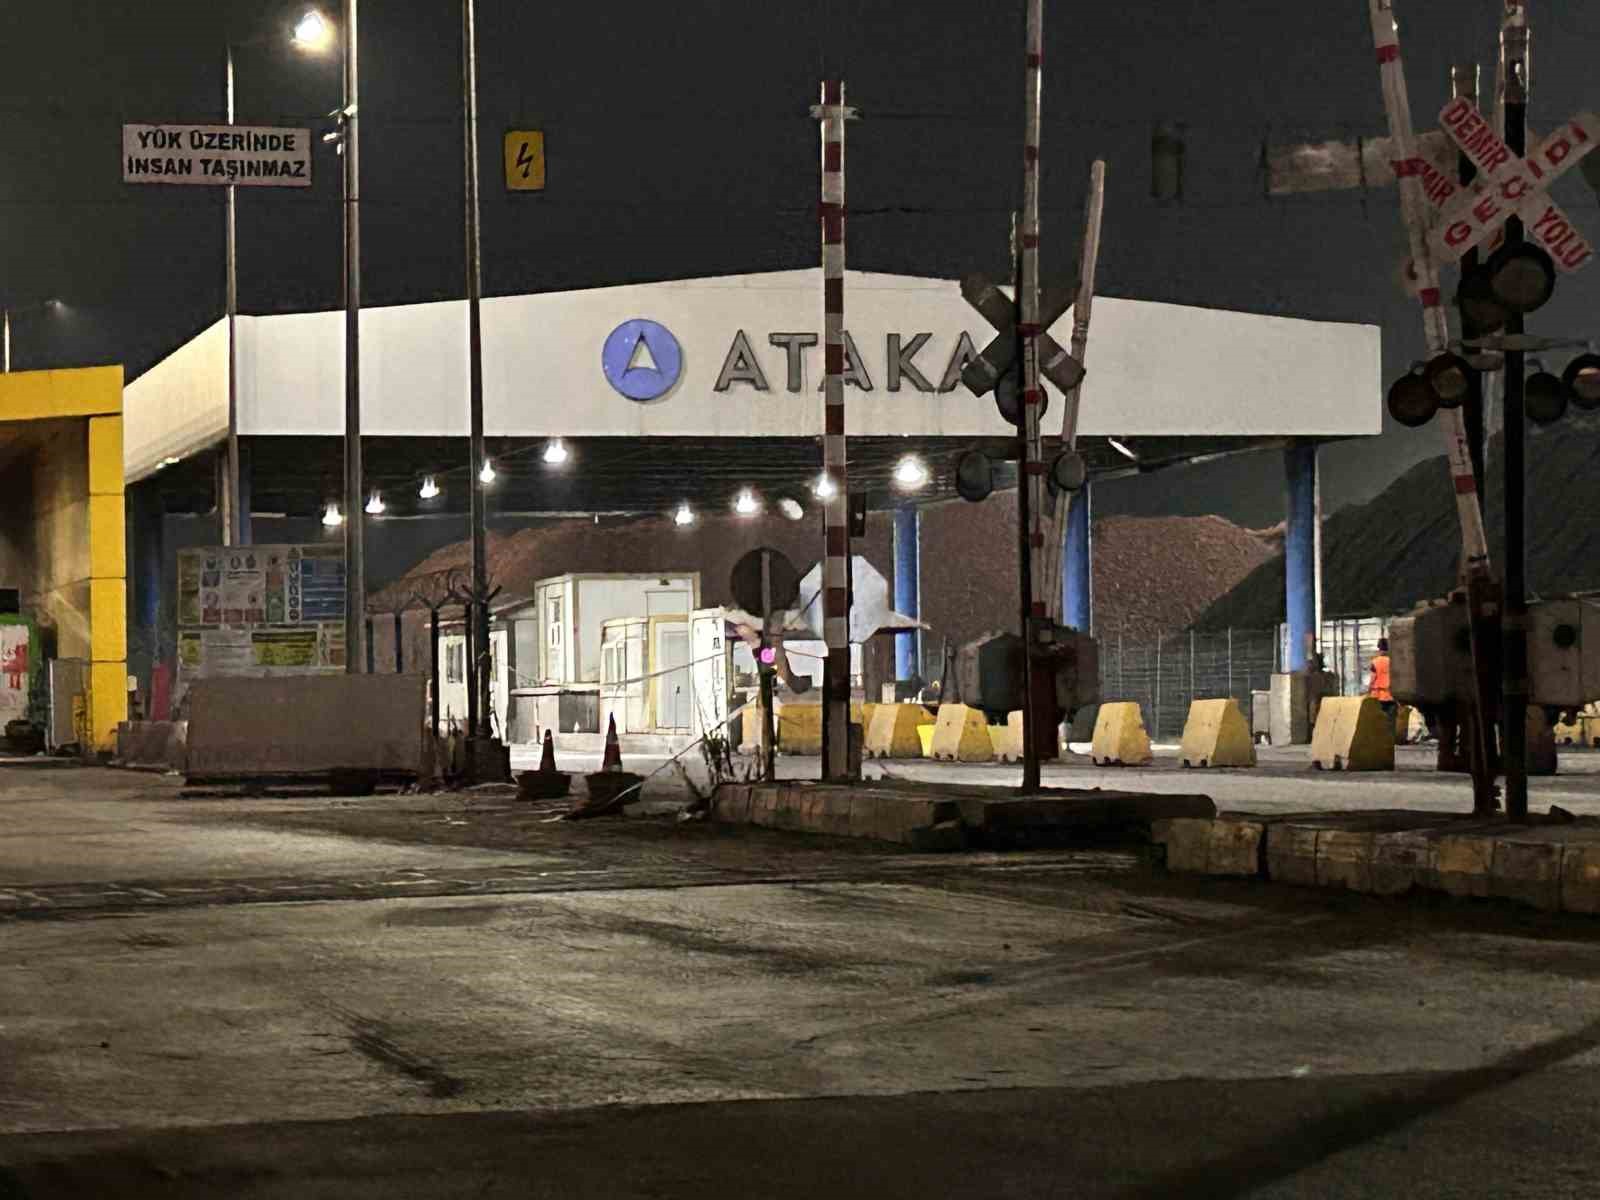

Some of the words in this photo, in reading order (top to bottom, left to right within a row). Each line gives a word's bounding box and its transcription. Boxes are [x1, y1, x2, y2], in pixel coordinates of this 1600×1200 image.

[138, 129, 183, 149] YÜK
[190, 130, 296, 152] ÜZERİNDE
[127, 156, 192, 175] İNSAN
[200, 159, 306, 180] TAŞINMAZ
[1533, 206, 1590, 268] YOLU
